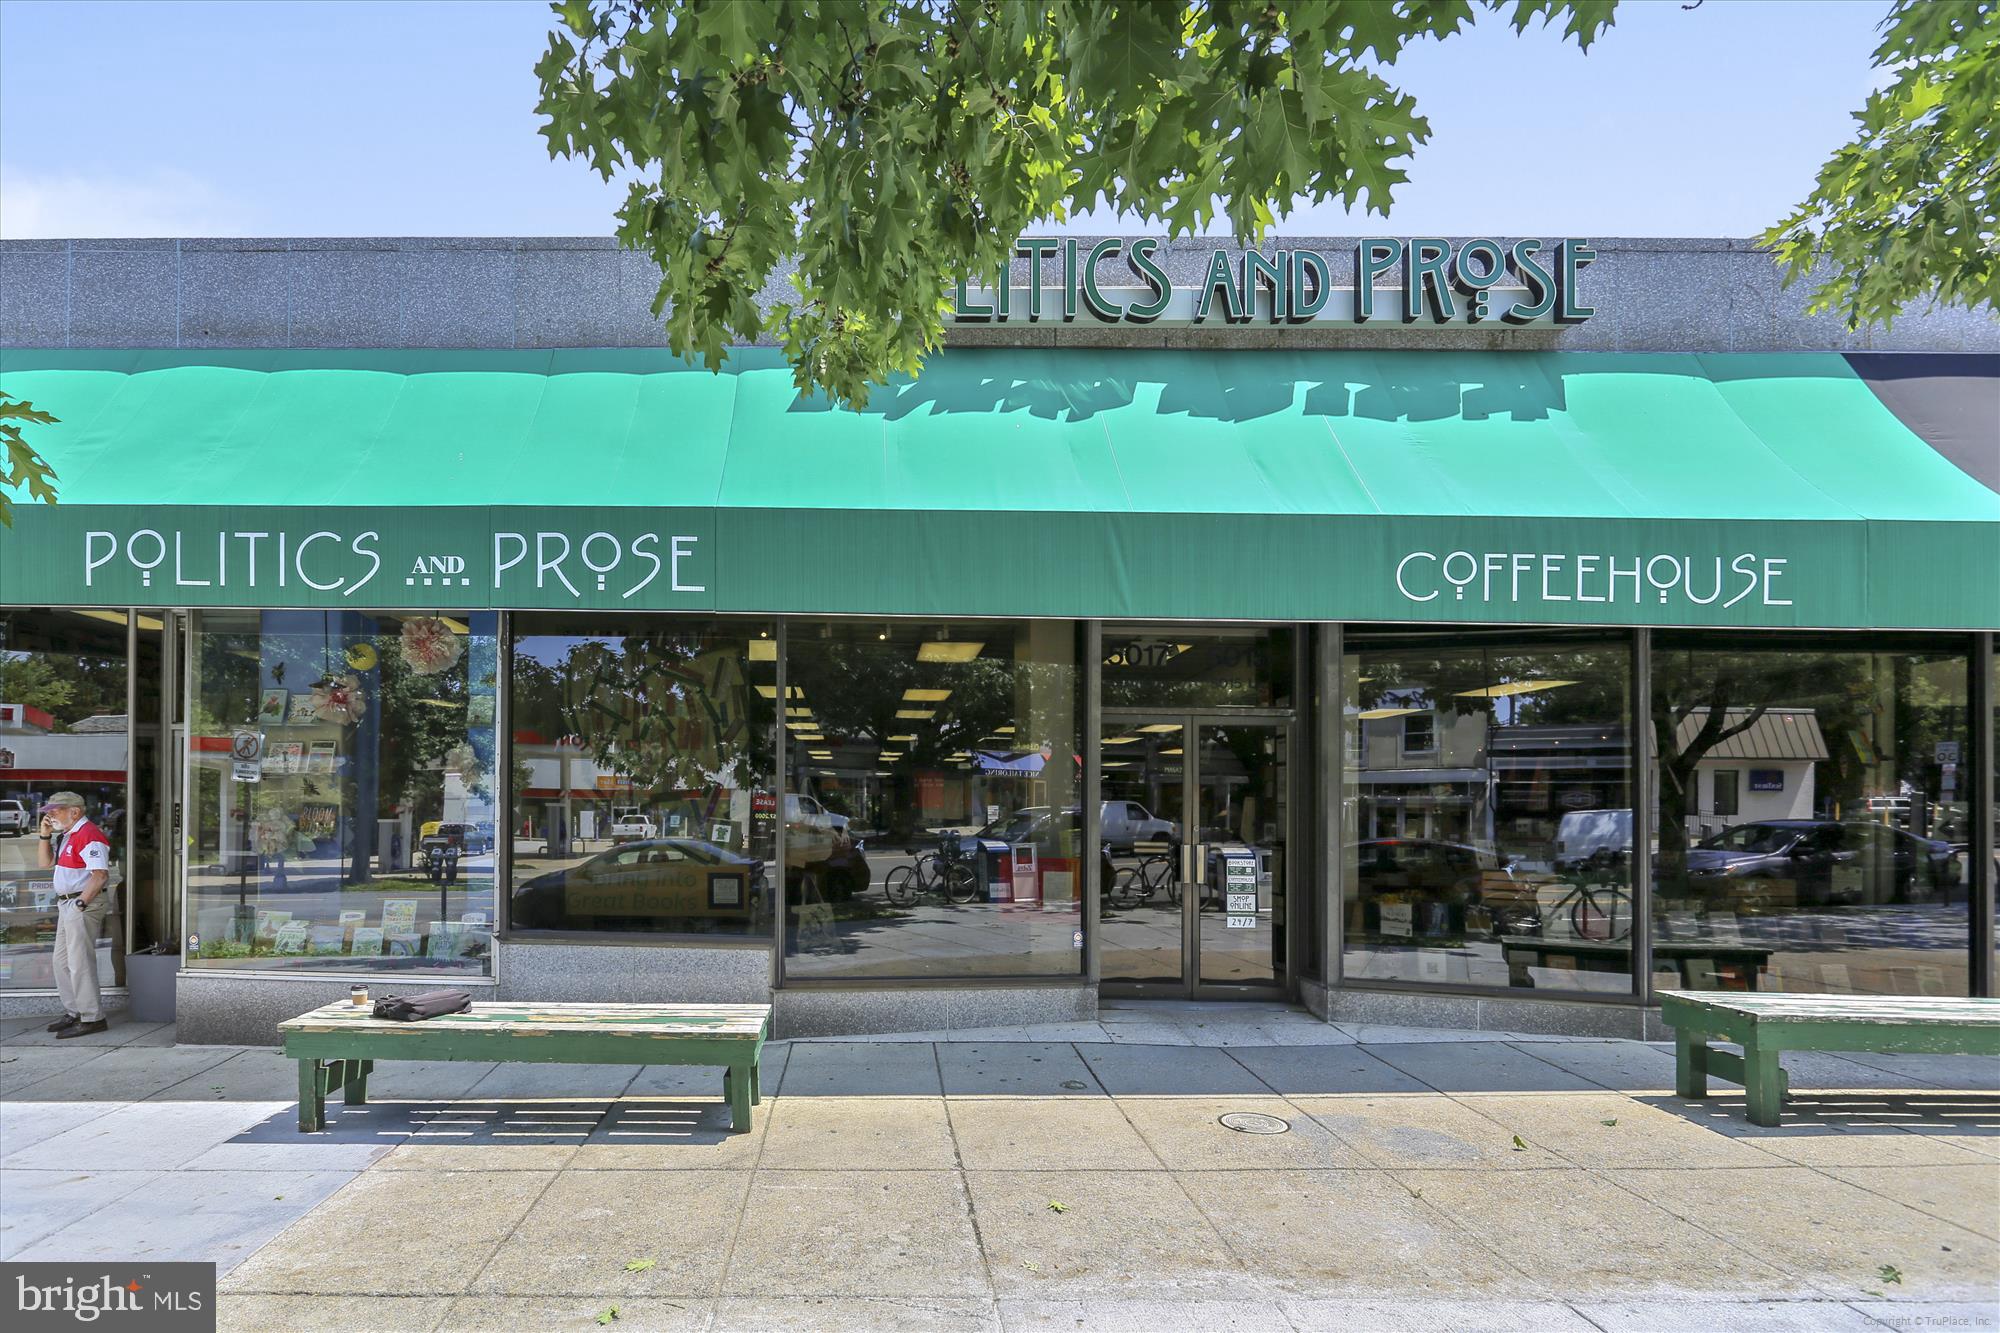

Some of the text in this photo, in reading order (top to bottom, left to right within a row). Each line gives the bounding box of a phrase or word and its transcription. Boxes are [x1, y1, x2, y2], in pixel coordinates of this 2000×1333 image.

[955, 237, 1598, 320] LITICS AND PROSE
[85, 529, 706, 599] POLITICS AND PROSE
[1396, 551, 1793, 608] COFFEEHOUSE
[31, 882, 55, 890] PRIDE
[1232, 917, 1253, 927] 24/7
